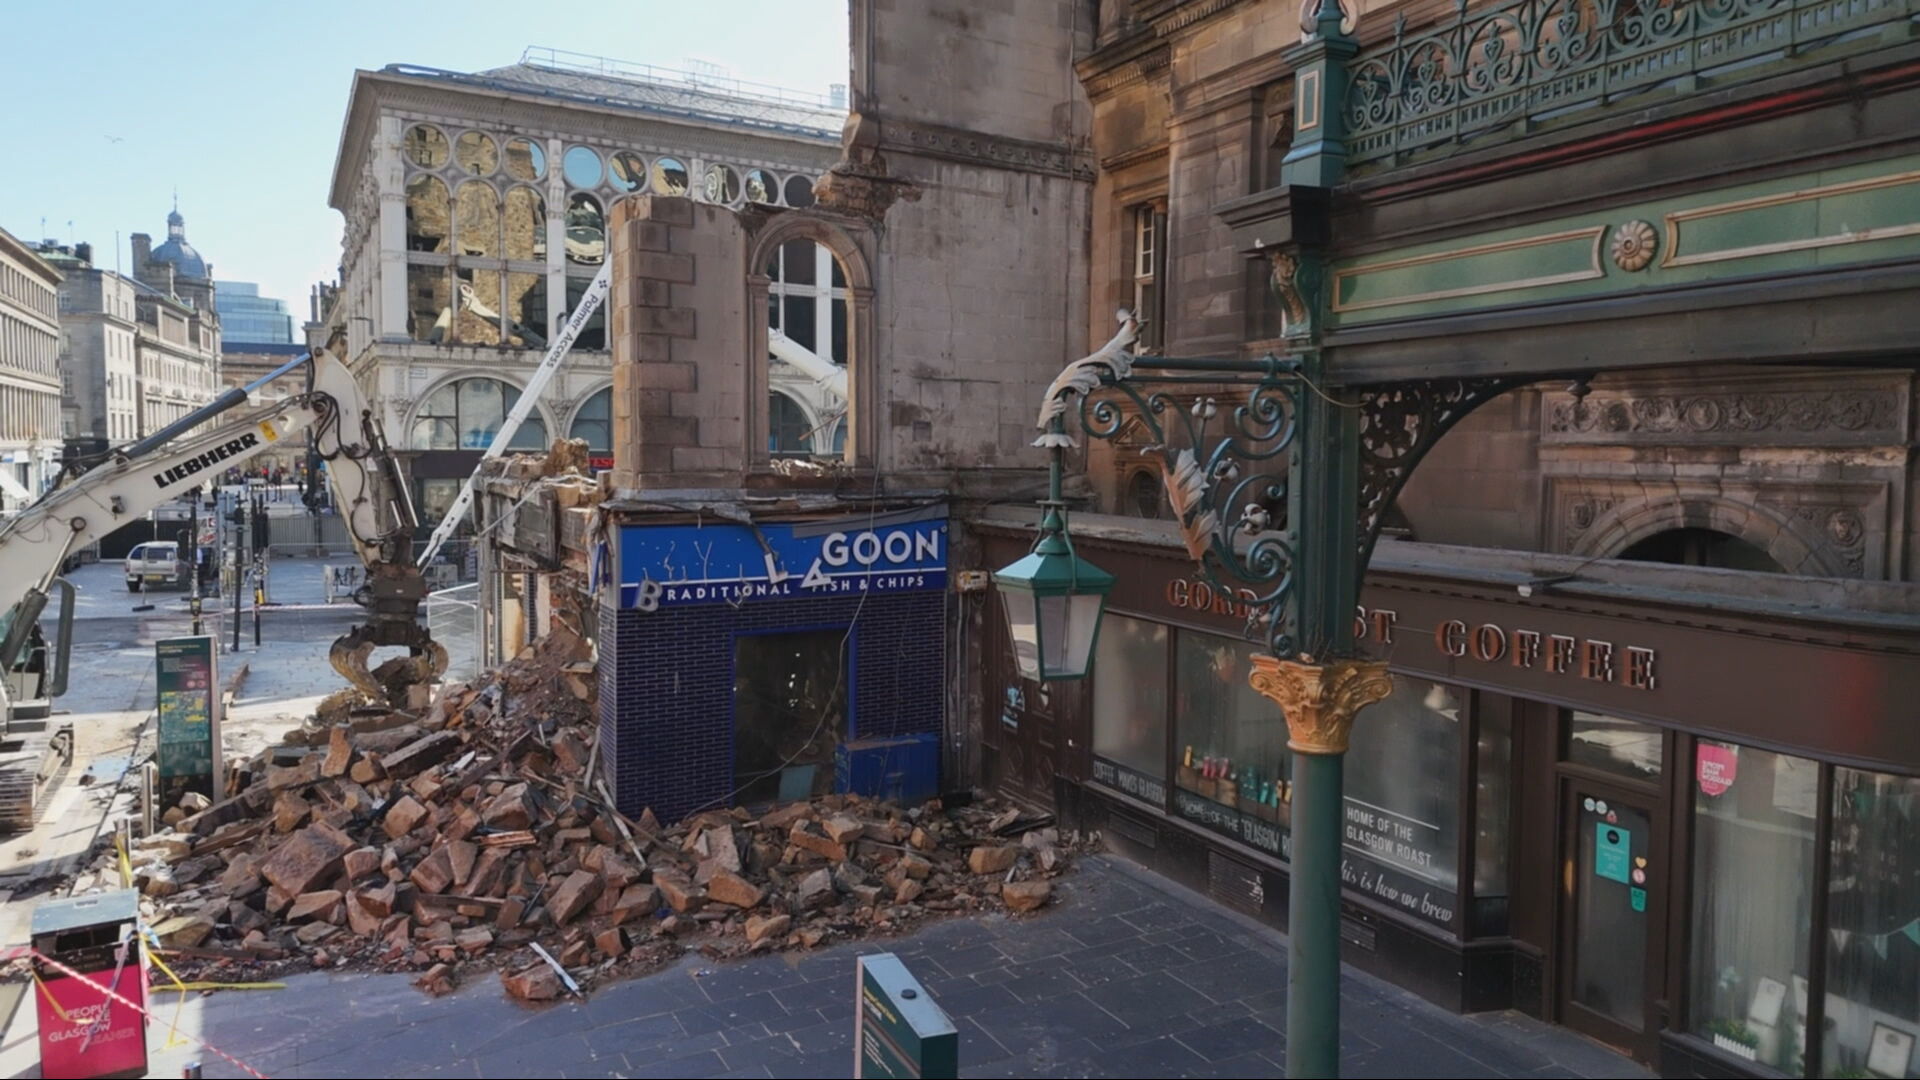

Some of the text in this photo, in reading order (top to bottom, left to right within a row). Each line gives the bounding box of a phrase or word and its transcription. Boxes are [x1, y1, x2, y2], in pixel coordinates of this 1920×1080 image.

[546, 293, 599, 369] Palmer Access
[153, 432, 259, 489] LIEBHERR
[822, 530, 939, 567] GOON
[667, 583, 791, 601] RADITIONAL
[859, 579, 868, 590] &
[877, 575, 924, 588] CHIPS
[1434, 618, 1656, 691] COFFEE
[1212, 811, 1221, 825] OF
[1224, 814, 1239, 832] THE
[1346, 807, 1413, 842] HOME OF THE
[1346, 825, 1432, 867] GLASGOW ROAST
[1341, 860, 1453, 922] his is how we brew
